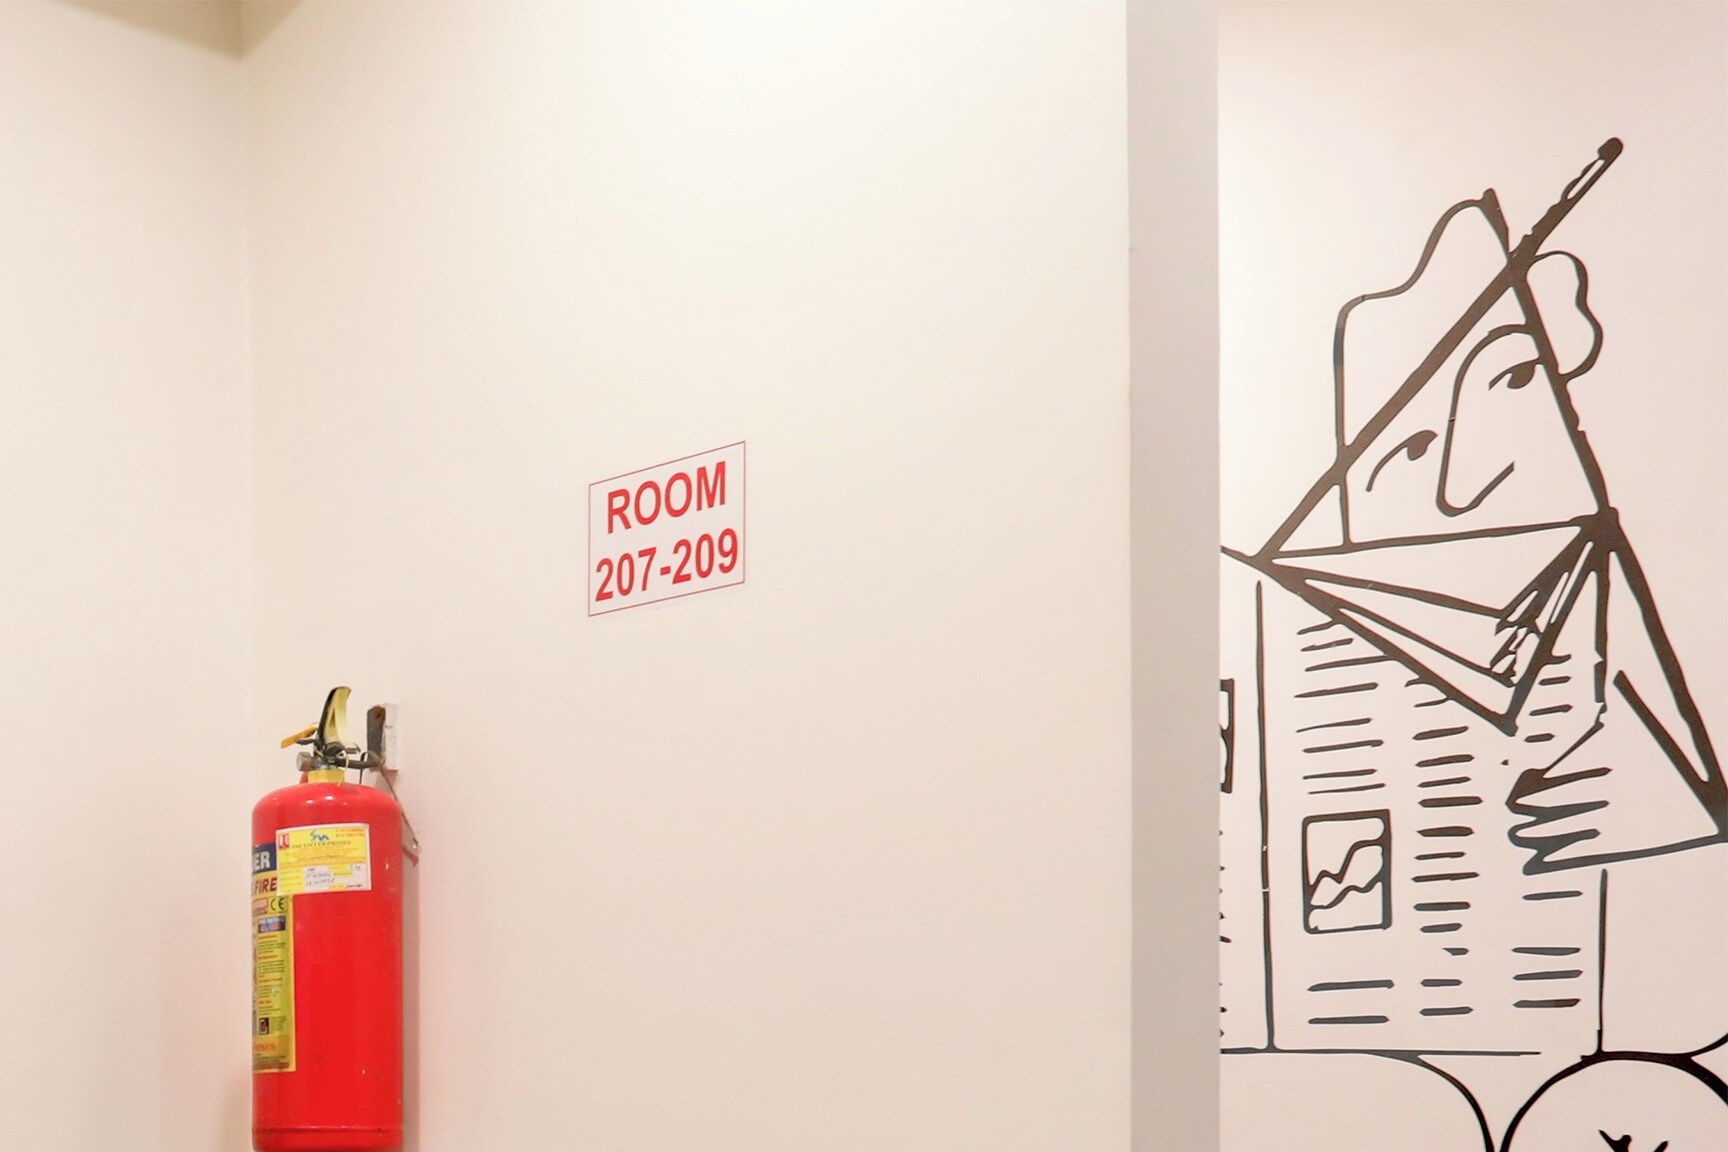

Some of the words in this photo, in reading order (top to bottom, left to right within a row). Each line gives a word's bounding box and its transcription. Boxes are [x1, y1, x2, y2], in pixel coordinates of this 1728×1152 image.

[607, 460, 727, 535] ROOM
[595, 527, 739, 602] 207-209
[254, 877, 277, 894] FIRE
